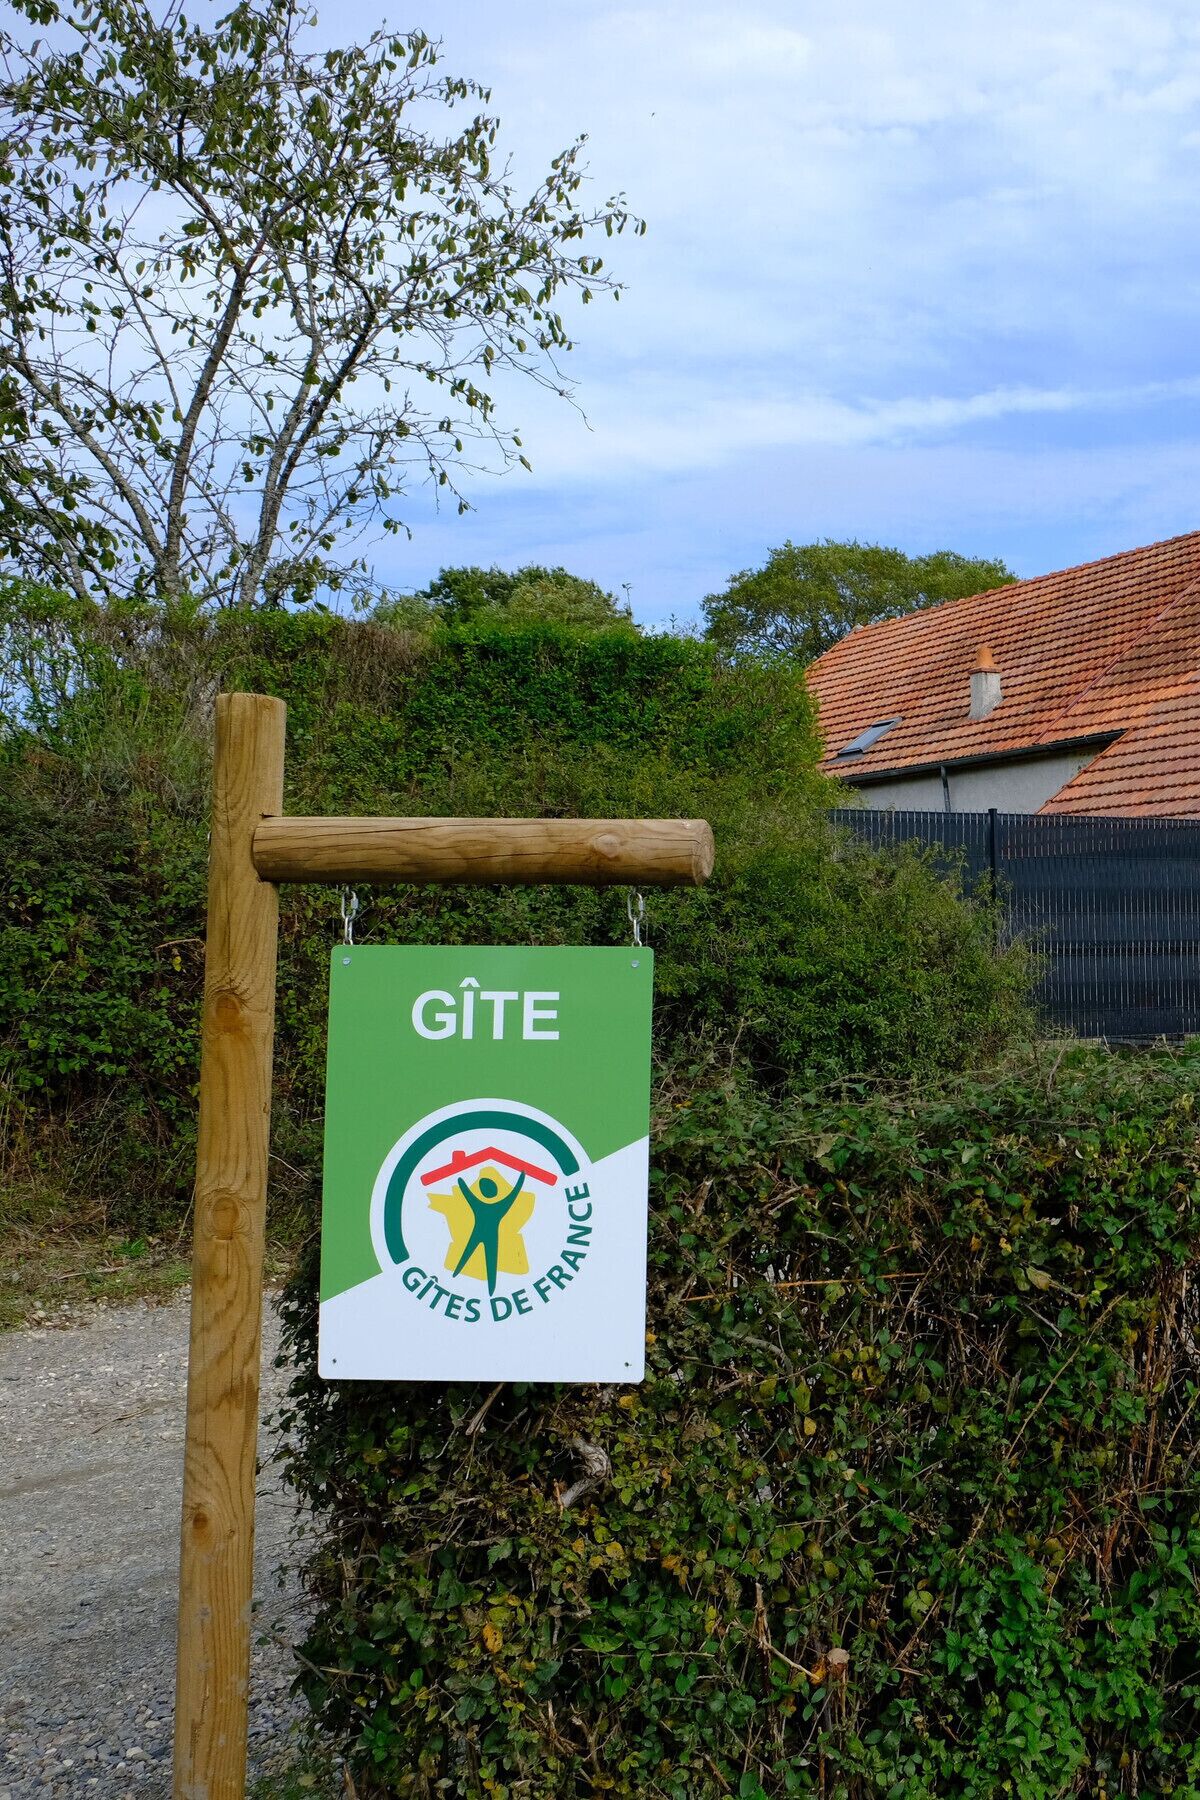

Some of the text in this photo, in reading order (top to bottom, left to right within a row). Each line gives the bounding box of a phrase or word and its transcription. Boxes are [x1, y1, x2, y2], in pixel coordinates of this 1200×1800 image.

[411, 977, 561, 1041] GÎTE
[402, 1182, 593, 1323] GÎTES DE FRANCE
